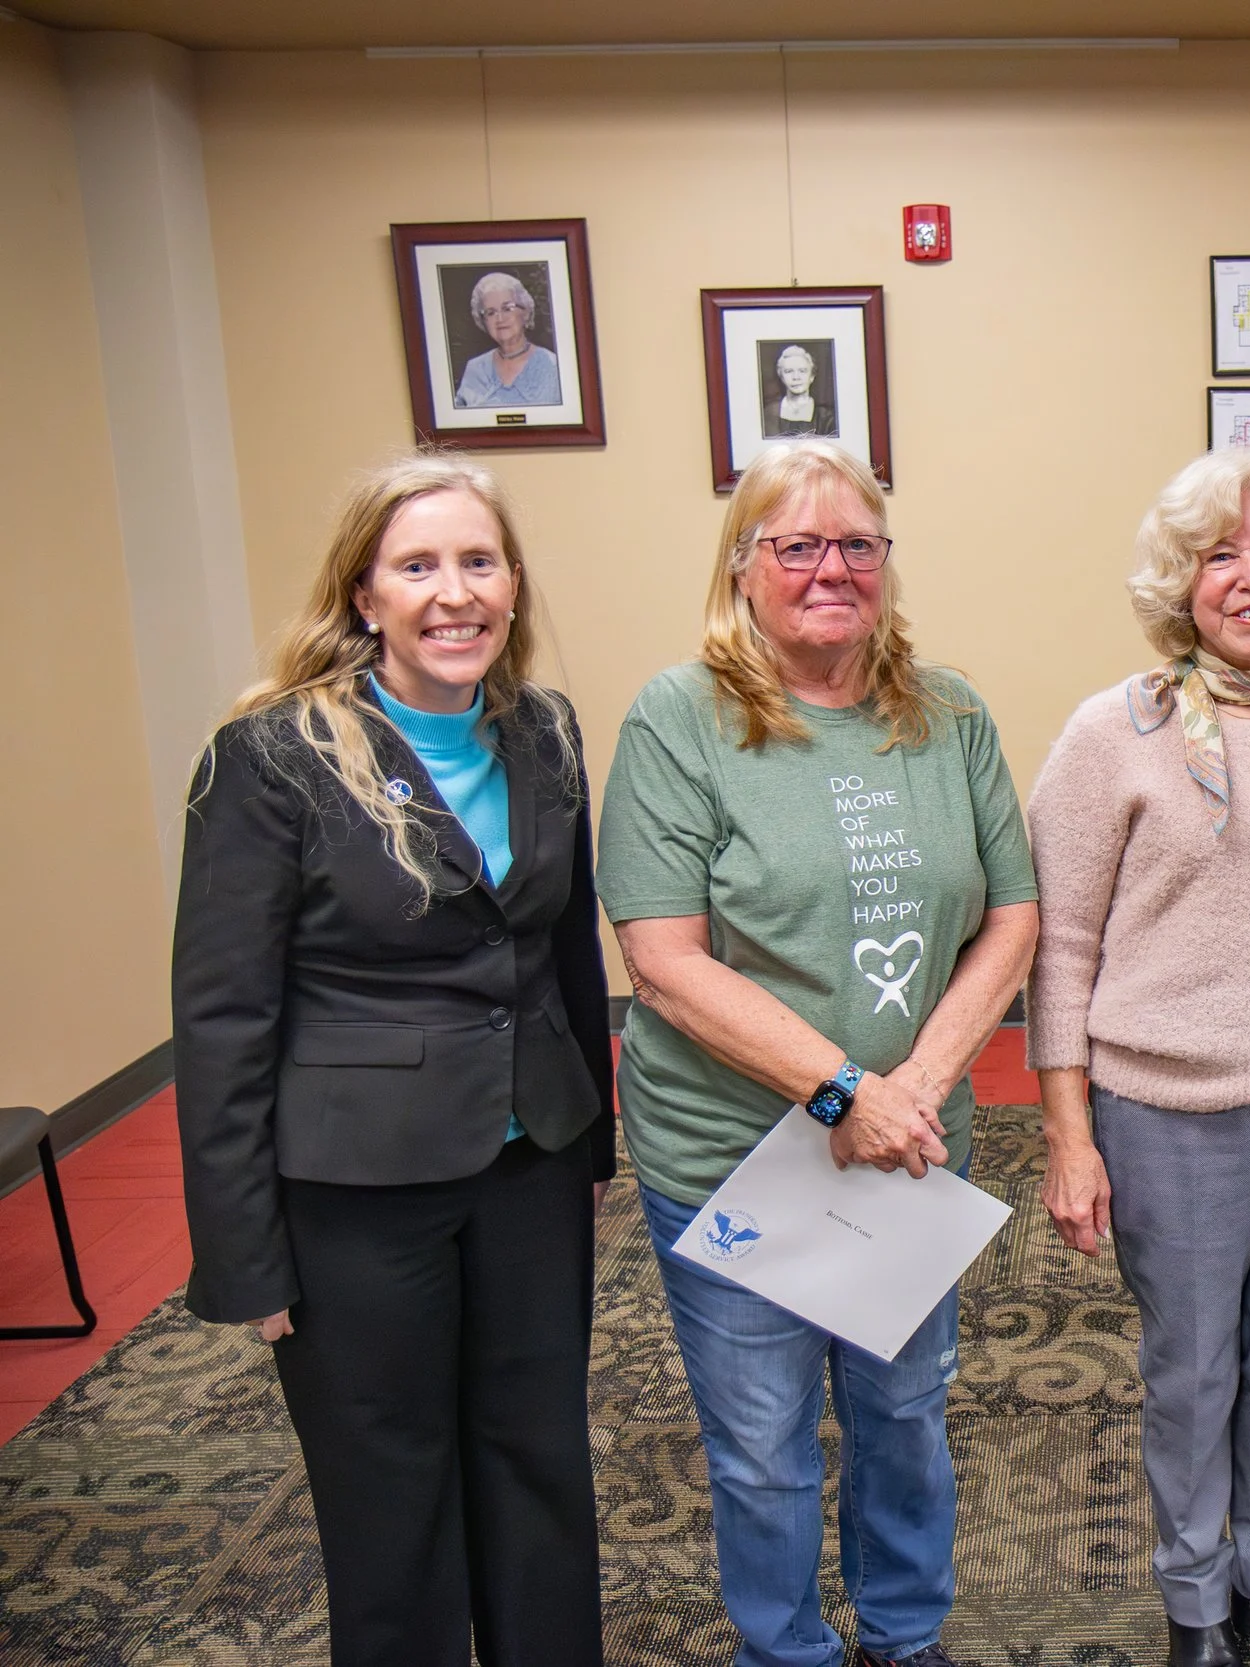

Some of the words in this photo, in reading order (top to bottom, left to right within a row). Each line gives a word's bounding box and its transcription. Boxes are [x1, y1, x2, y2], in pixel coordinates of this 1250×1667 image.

[830, 775, 864, 793] DO
[836, 790, 899, 813] MORE
[841, 814, 870, 831] OF
[844, 828, 905, 850] WHAT
[852, 849, 922, 873] MAKES
[851, 875, 898, 897] YOU
[854, 899, 924, 925] HAPPY
